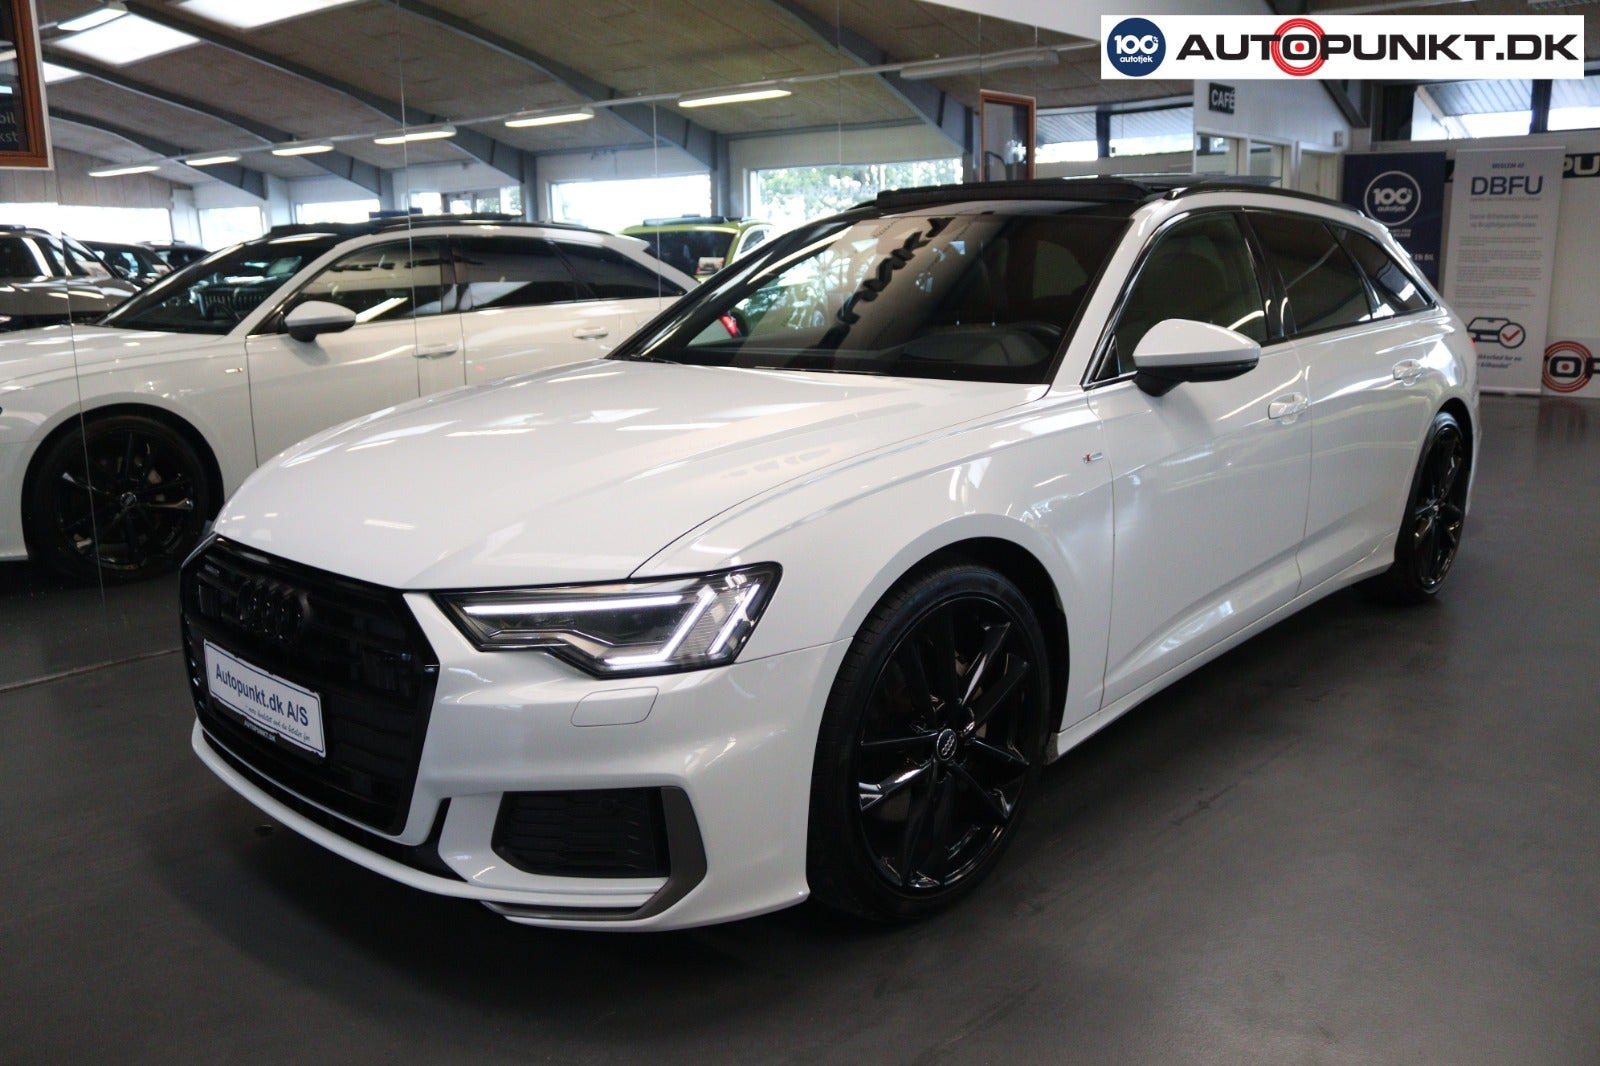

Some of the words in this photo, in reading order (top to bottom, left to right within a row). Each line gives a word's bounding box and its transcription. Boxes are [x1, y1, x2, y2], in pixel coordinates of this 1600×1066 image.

[1471, 175, 1544, 196] DBFU
[215, 663, 285, 716] Autopunkt.dk
[286, 700, 309, 727] A/S
